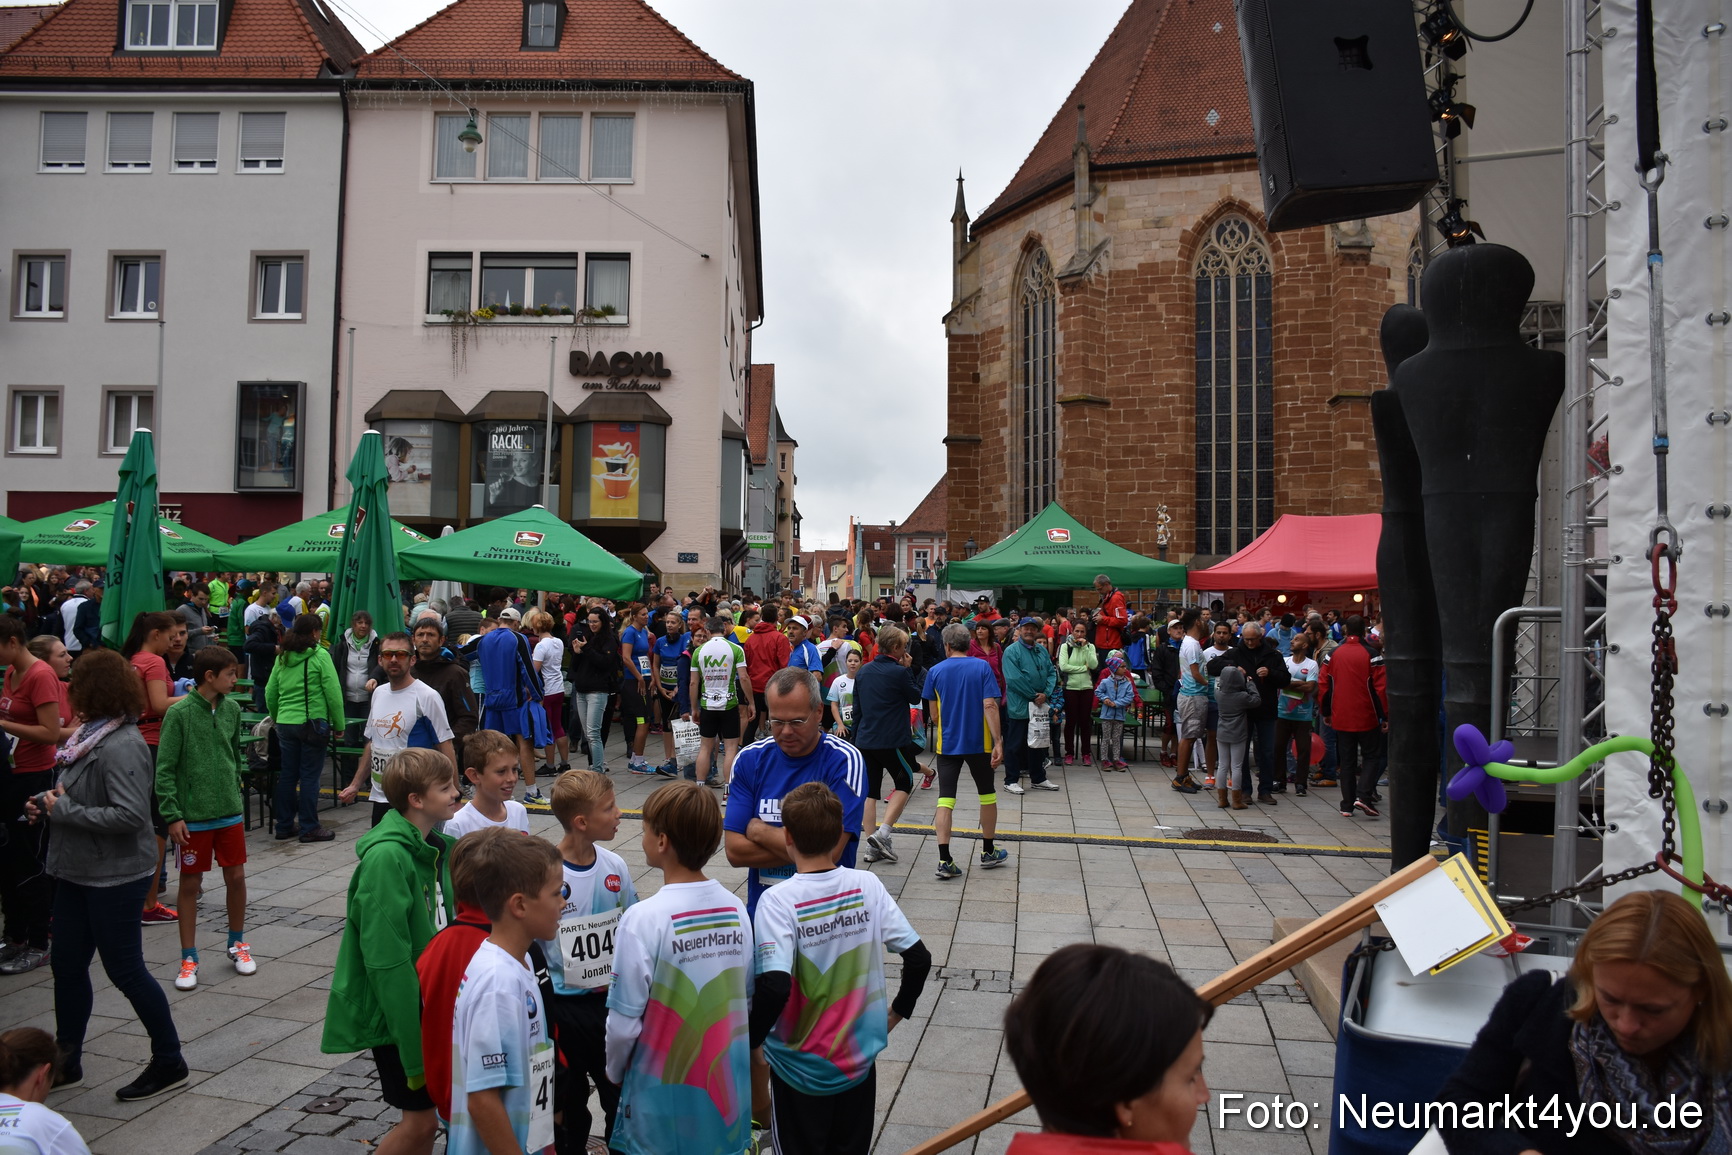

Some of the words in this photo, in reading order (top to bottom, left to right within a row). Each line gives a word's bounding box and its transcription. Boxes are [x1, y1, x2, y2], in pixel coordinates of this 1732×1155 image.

[569, 351, 671, 377] RACKL
[582, 381, 603, 390] am
[606, 377, 661, 391] Rathaus
[495, 425, 508, 433] 100
[508, 425, 529, 433] Jahre
[492, 434, 523, 449] RACKL
[159, 508, 181, 521] atz
[22, 539, 96, 548] ammsbräu
[287, 545, 341, 553] Lamms
[473, 551, 571, 567] Lammsbräu
[489, 546, 561, 558] Neumarkter
[767, 867, 798, 877] Christi
[561, 924, 587, 934] PARTL
[587, 918, 617, 930] Neumarkt
[797, 910, 870, 939] NeuerMarkt
[671, 930, 743, 955] NeuerMarkt
[582, 963, 612, 979] Jonath
[532, 1060, 551, 1074] PARTL
